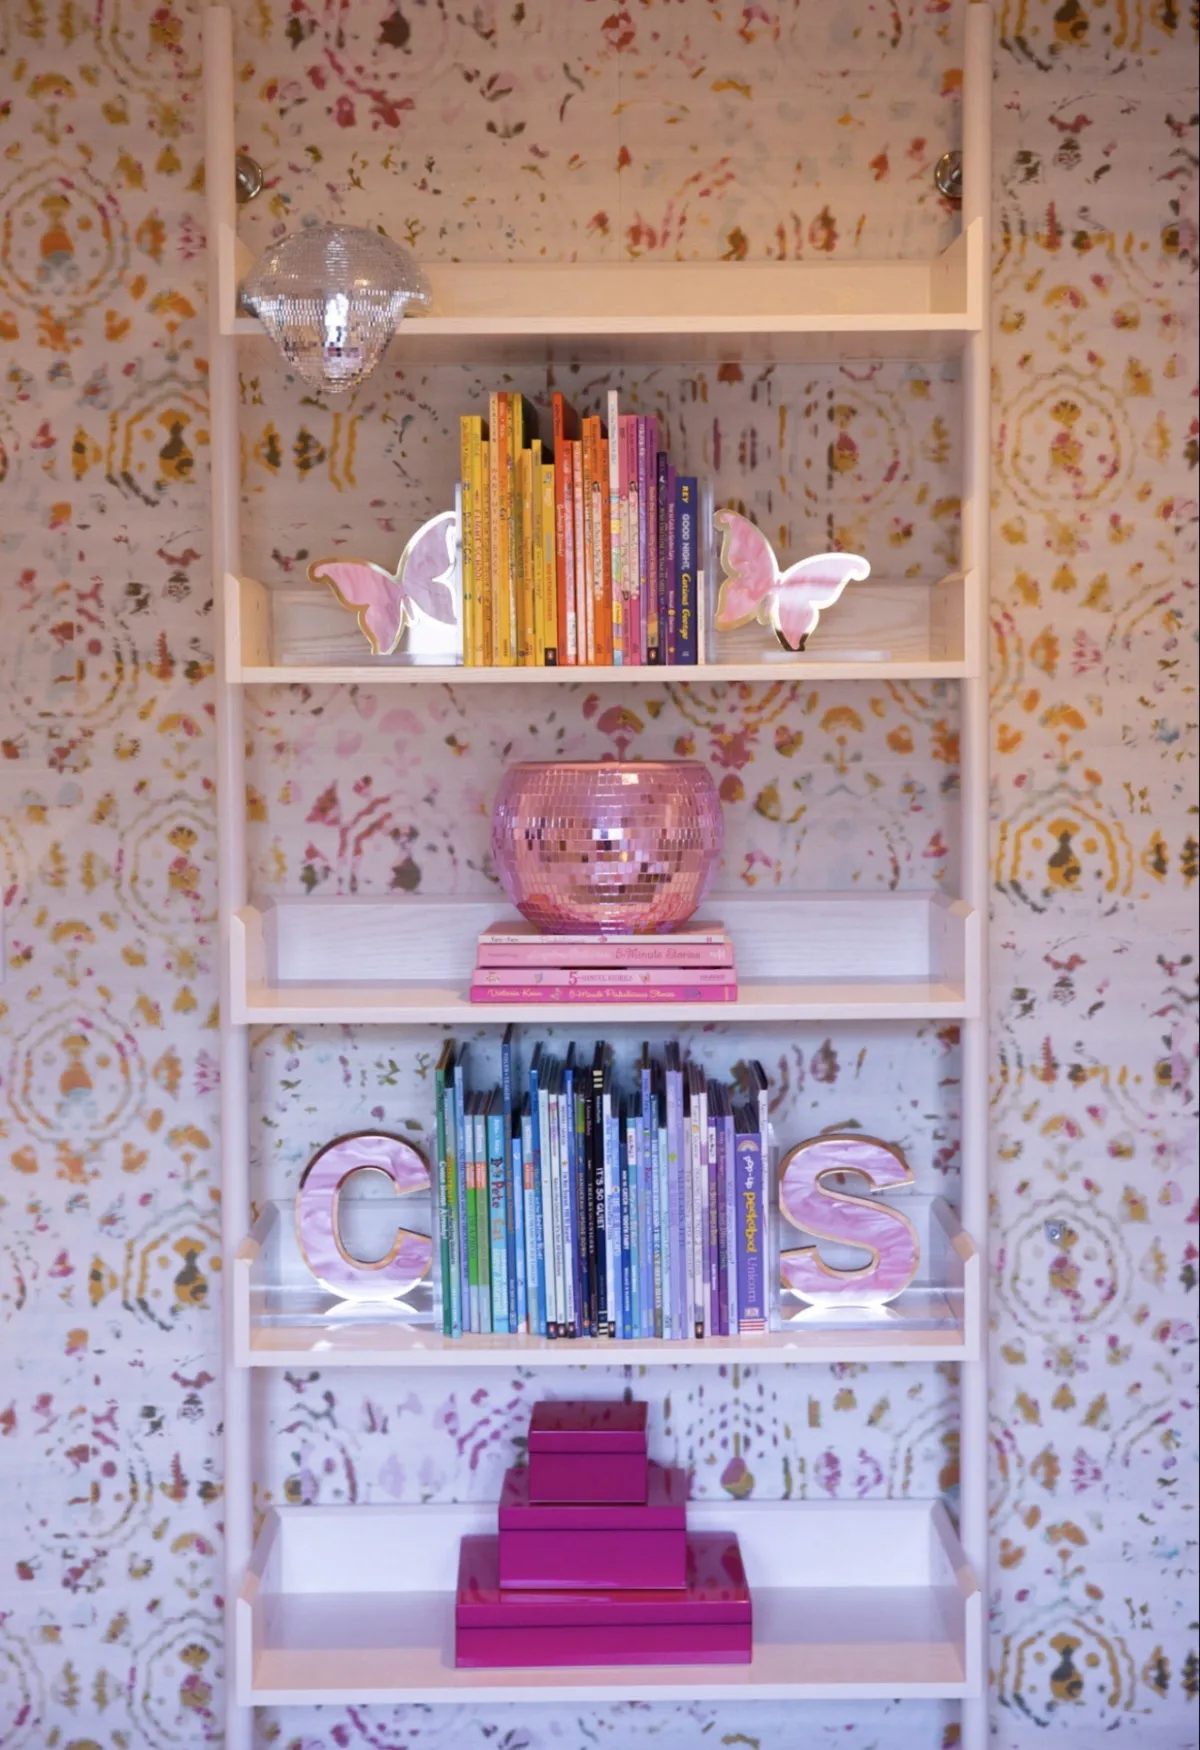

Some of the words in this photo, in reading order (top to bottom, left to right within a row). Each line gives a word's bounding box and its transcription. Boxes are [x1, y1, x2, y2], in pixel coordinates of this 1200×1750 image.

[681, 485, 690, 503] REY
[681, 513, 691, 540] GOOD
[680, 542, 690, 570] NIGHT,
[681, 572, 692, 607] Curious
[679, 608, 691, 641] George
[595, 1167, 604, 1186] IT'S
[742, 1155, 755, 1189] pop-up
[491, 1181, 506, 1209] Pete
[596, 1187, 604, 1201] SO
[296, 1129, 432, 1301] C
[596, 1203, 605, 1231] QUIET
[778, 1133, 920, 1306] S
[747, 1256, 759, 1304] Unicorn
